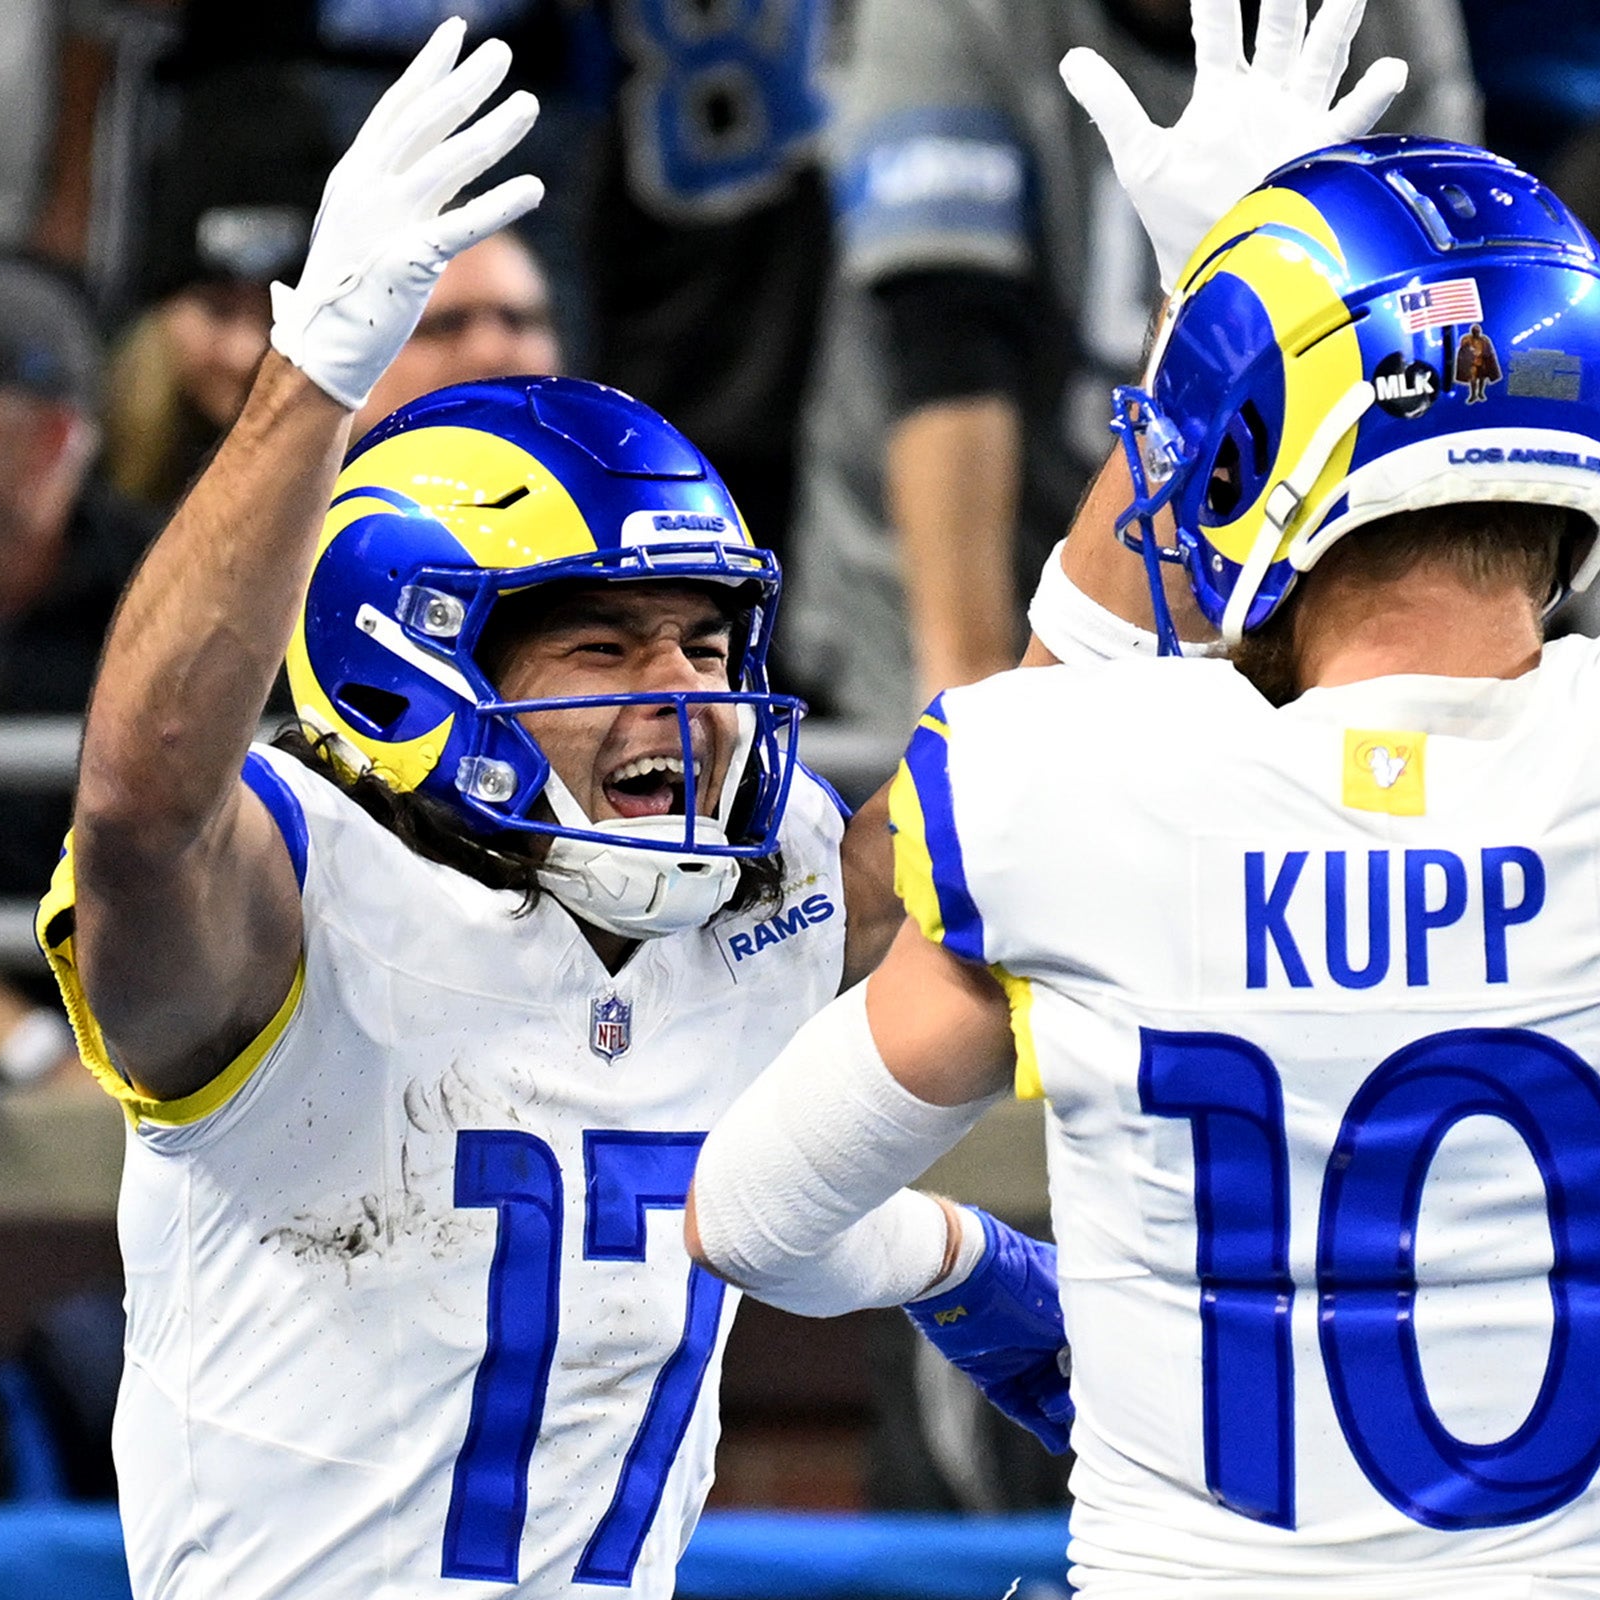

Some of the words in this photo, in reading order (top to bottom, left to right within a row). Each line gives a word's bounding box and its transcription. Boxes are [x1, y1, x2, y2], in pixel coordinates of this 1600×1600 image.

[1375, 370, 1434, 400] MLK
[1448, 448, 1504, 465] LOS
[652, 514, 726, 533] RAMS
[728, 893, 835, 962] RAMS
[1244, 845, 1547, 989] KUPP
[598, 1023, 626, 1051] NFL
[440, 1128, 727, 1588] 17
